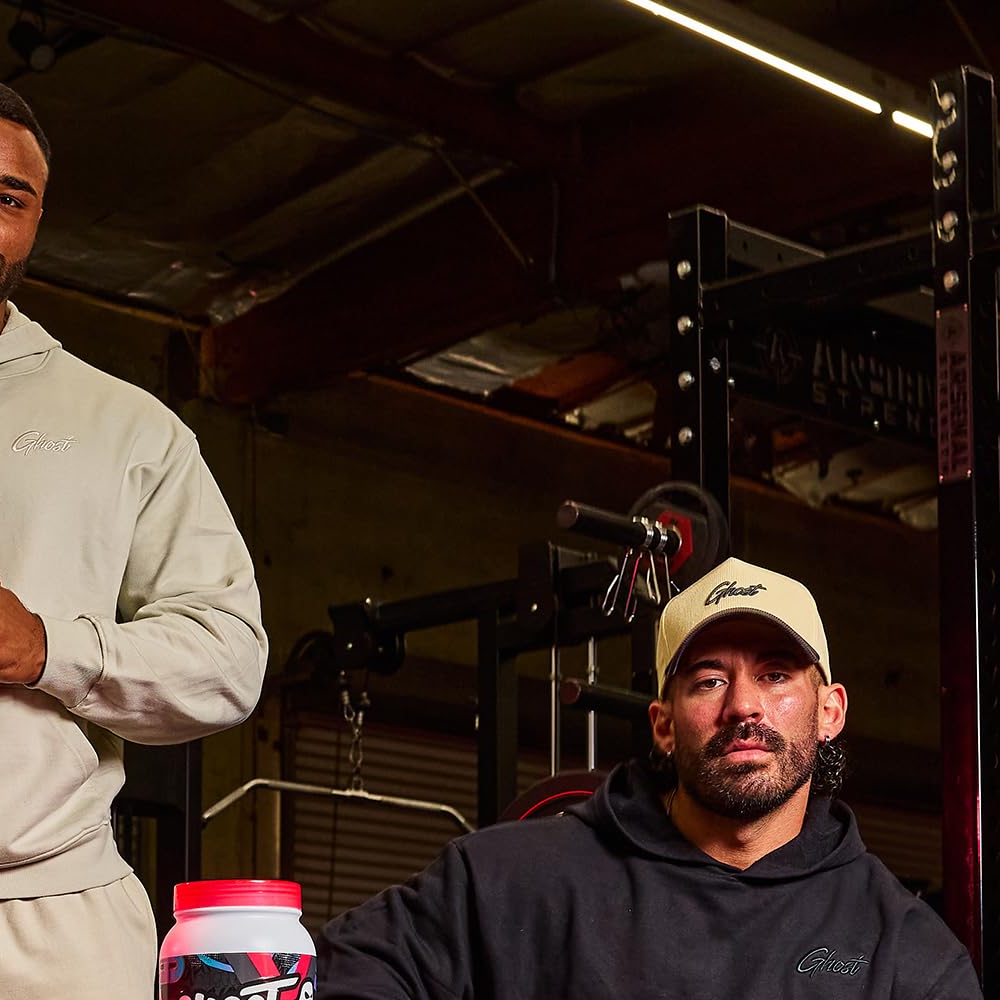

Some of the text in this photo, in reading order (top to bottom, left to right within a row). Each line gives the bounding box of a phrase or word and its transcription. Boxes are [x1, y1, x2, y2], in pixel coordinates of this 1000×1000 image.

[11, 430, 77, 456] Ghost
[703, 581, 767, 606] Ghost
[797, 947, 869, 978] Ghost
